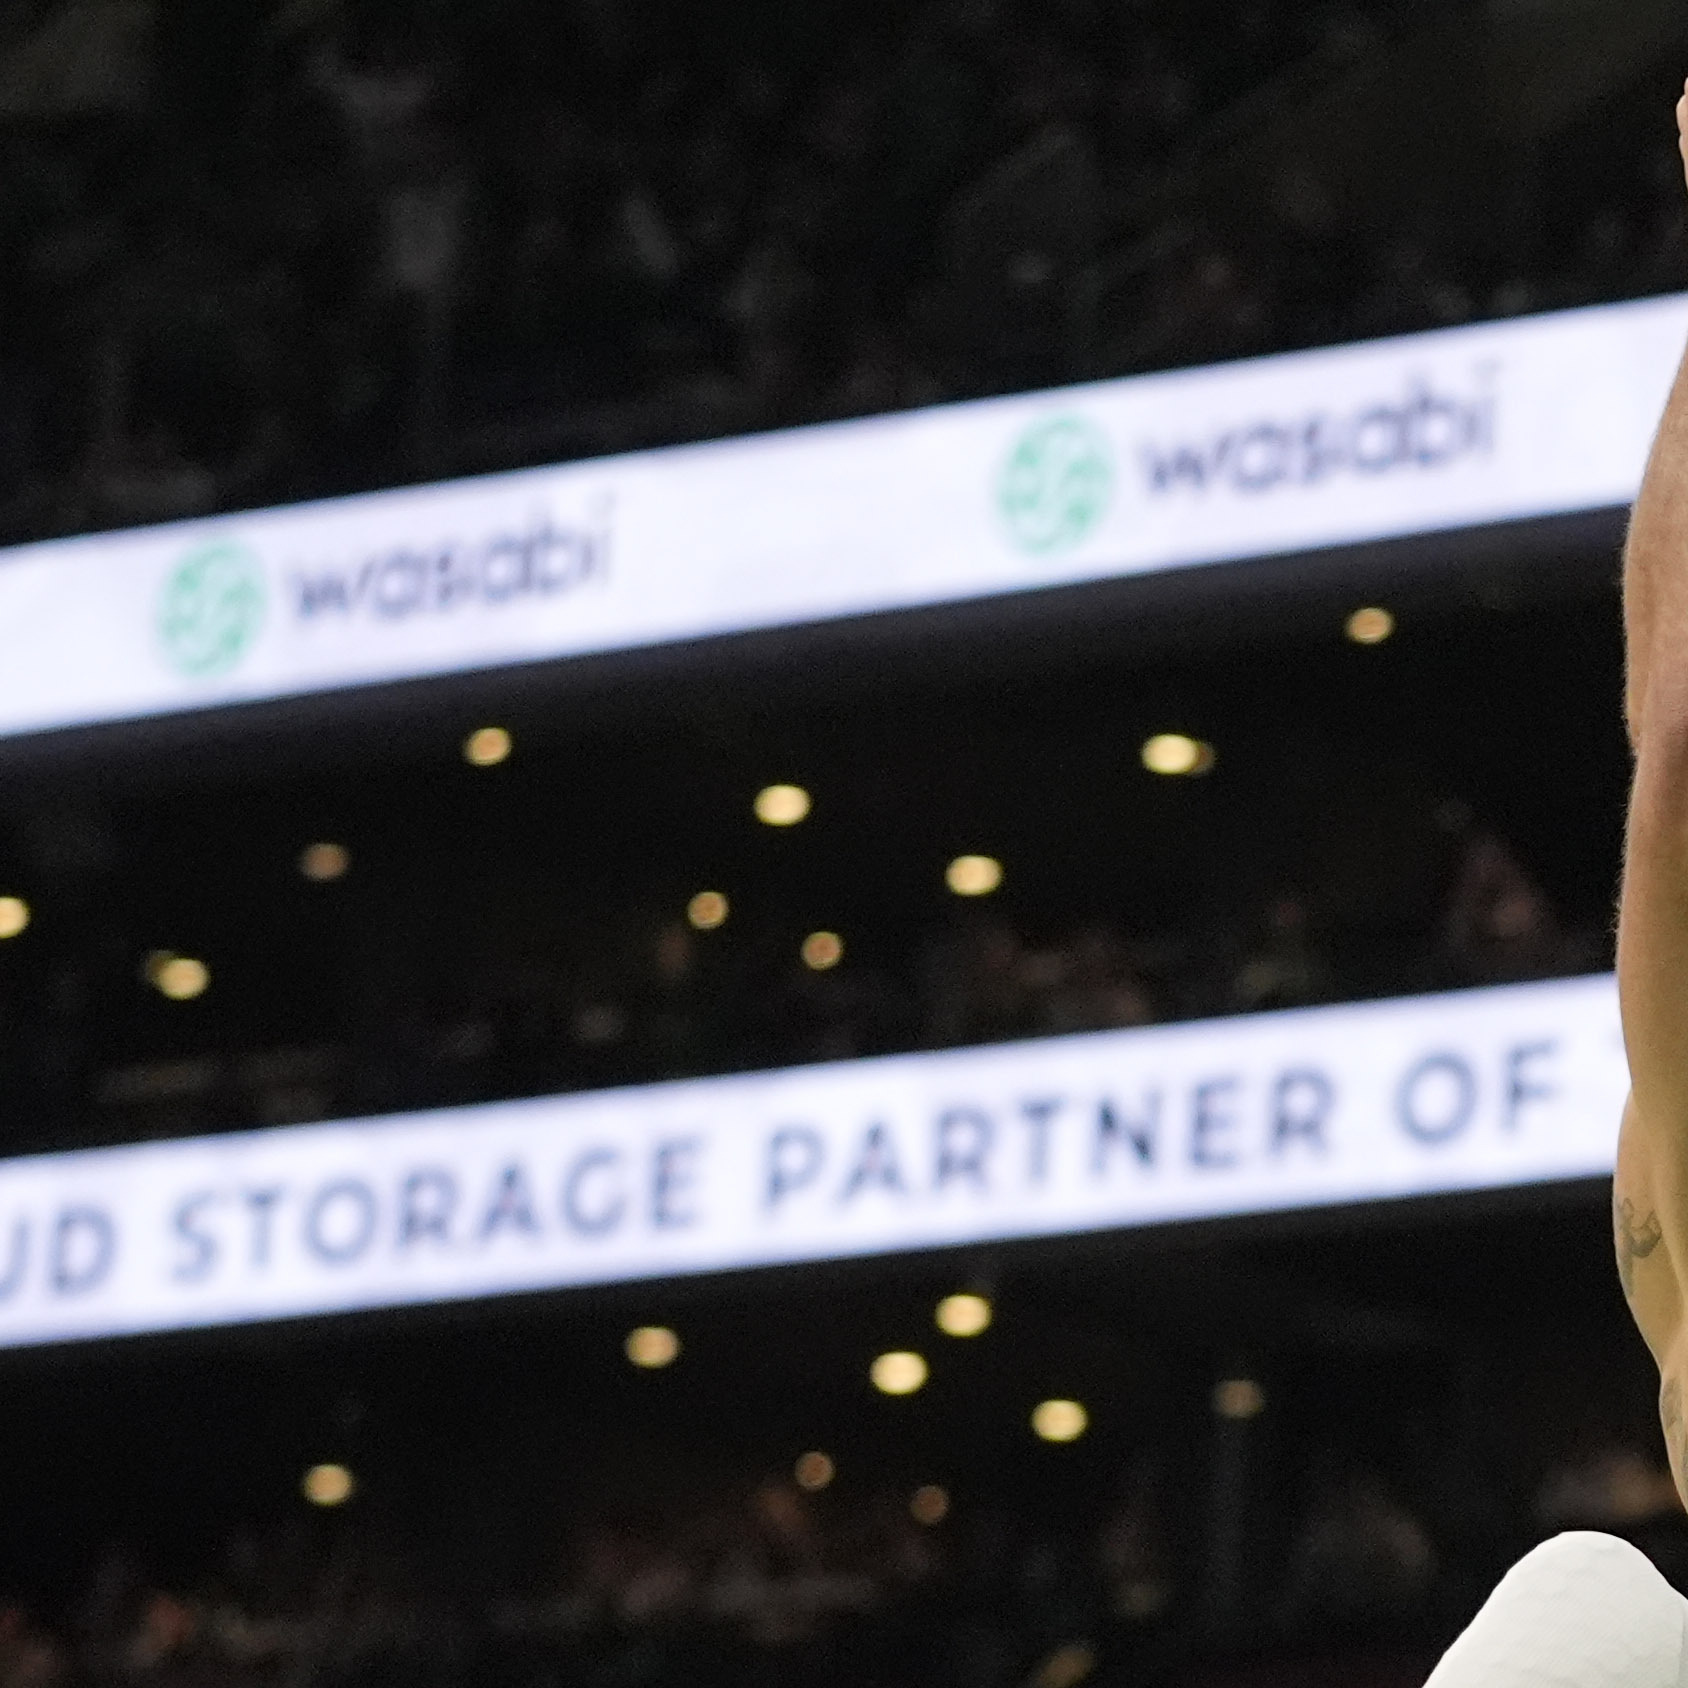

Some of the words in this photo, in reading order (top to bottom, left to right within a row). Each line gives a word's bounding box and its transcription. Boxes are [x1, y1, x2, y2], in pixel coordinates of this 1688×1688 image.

[1137, 358, 1508, 499] wasabi
[286, 490, 615, 626] wasabi
[168, 1132, 706, 1287] STORAGE
[762, 1062, 1337, 1203] PARTNER
[1392, 1032, 1570, 1145] OF
